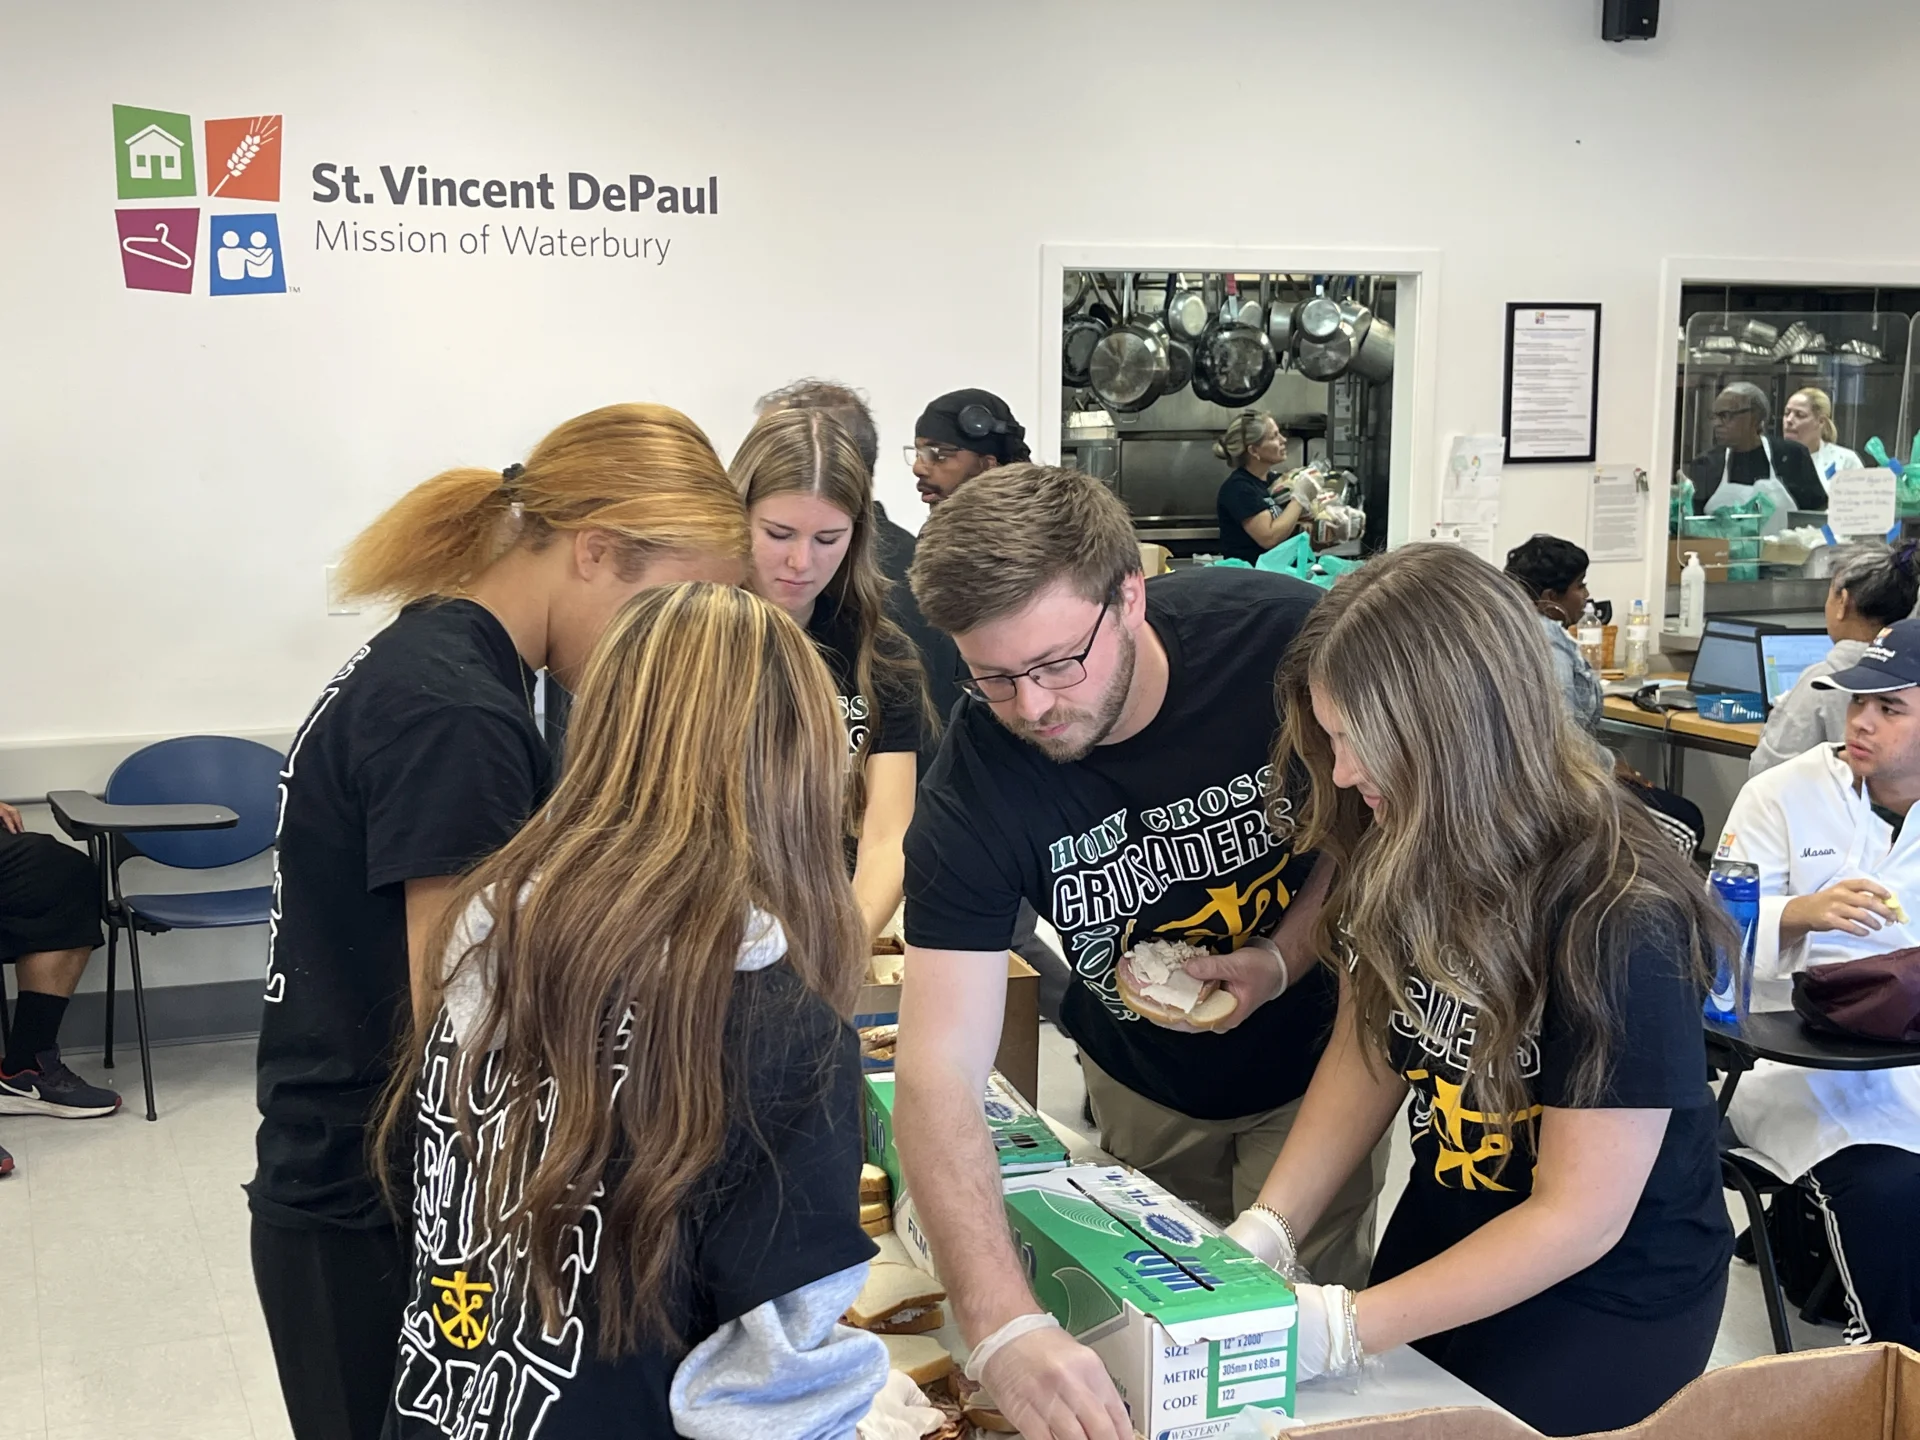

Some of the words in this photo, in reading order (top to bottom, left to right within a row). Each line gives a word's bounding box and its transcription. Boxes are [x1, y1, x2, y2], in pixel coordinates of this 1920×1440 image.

[312, 163, 374, 205] St.
[379, 165, 556, 211] Vincent
[568, 172, 719, 215] DePaul
[315, 220, 448, 254] Mission
[460, 223, 490, 255] of
[502, 225, 671, 266] Waterbury
[1048, 807, 1129, 873] HOLY
[1140, 763, 1283, 832] CROSS
[1051, 796, 1296, 931] CRUSADERS
[1799, 846, 1837, 860] Mason
[1164, 1346, 1190, 1359] SIZE
[1163, 1366, 1209, 1386] METRIC
[1222, 1362, 1247, 1377] 305mm
[1162, 1395, 1198, 1412] CODE
[1222, 1388, 1236, 1402] 122
